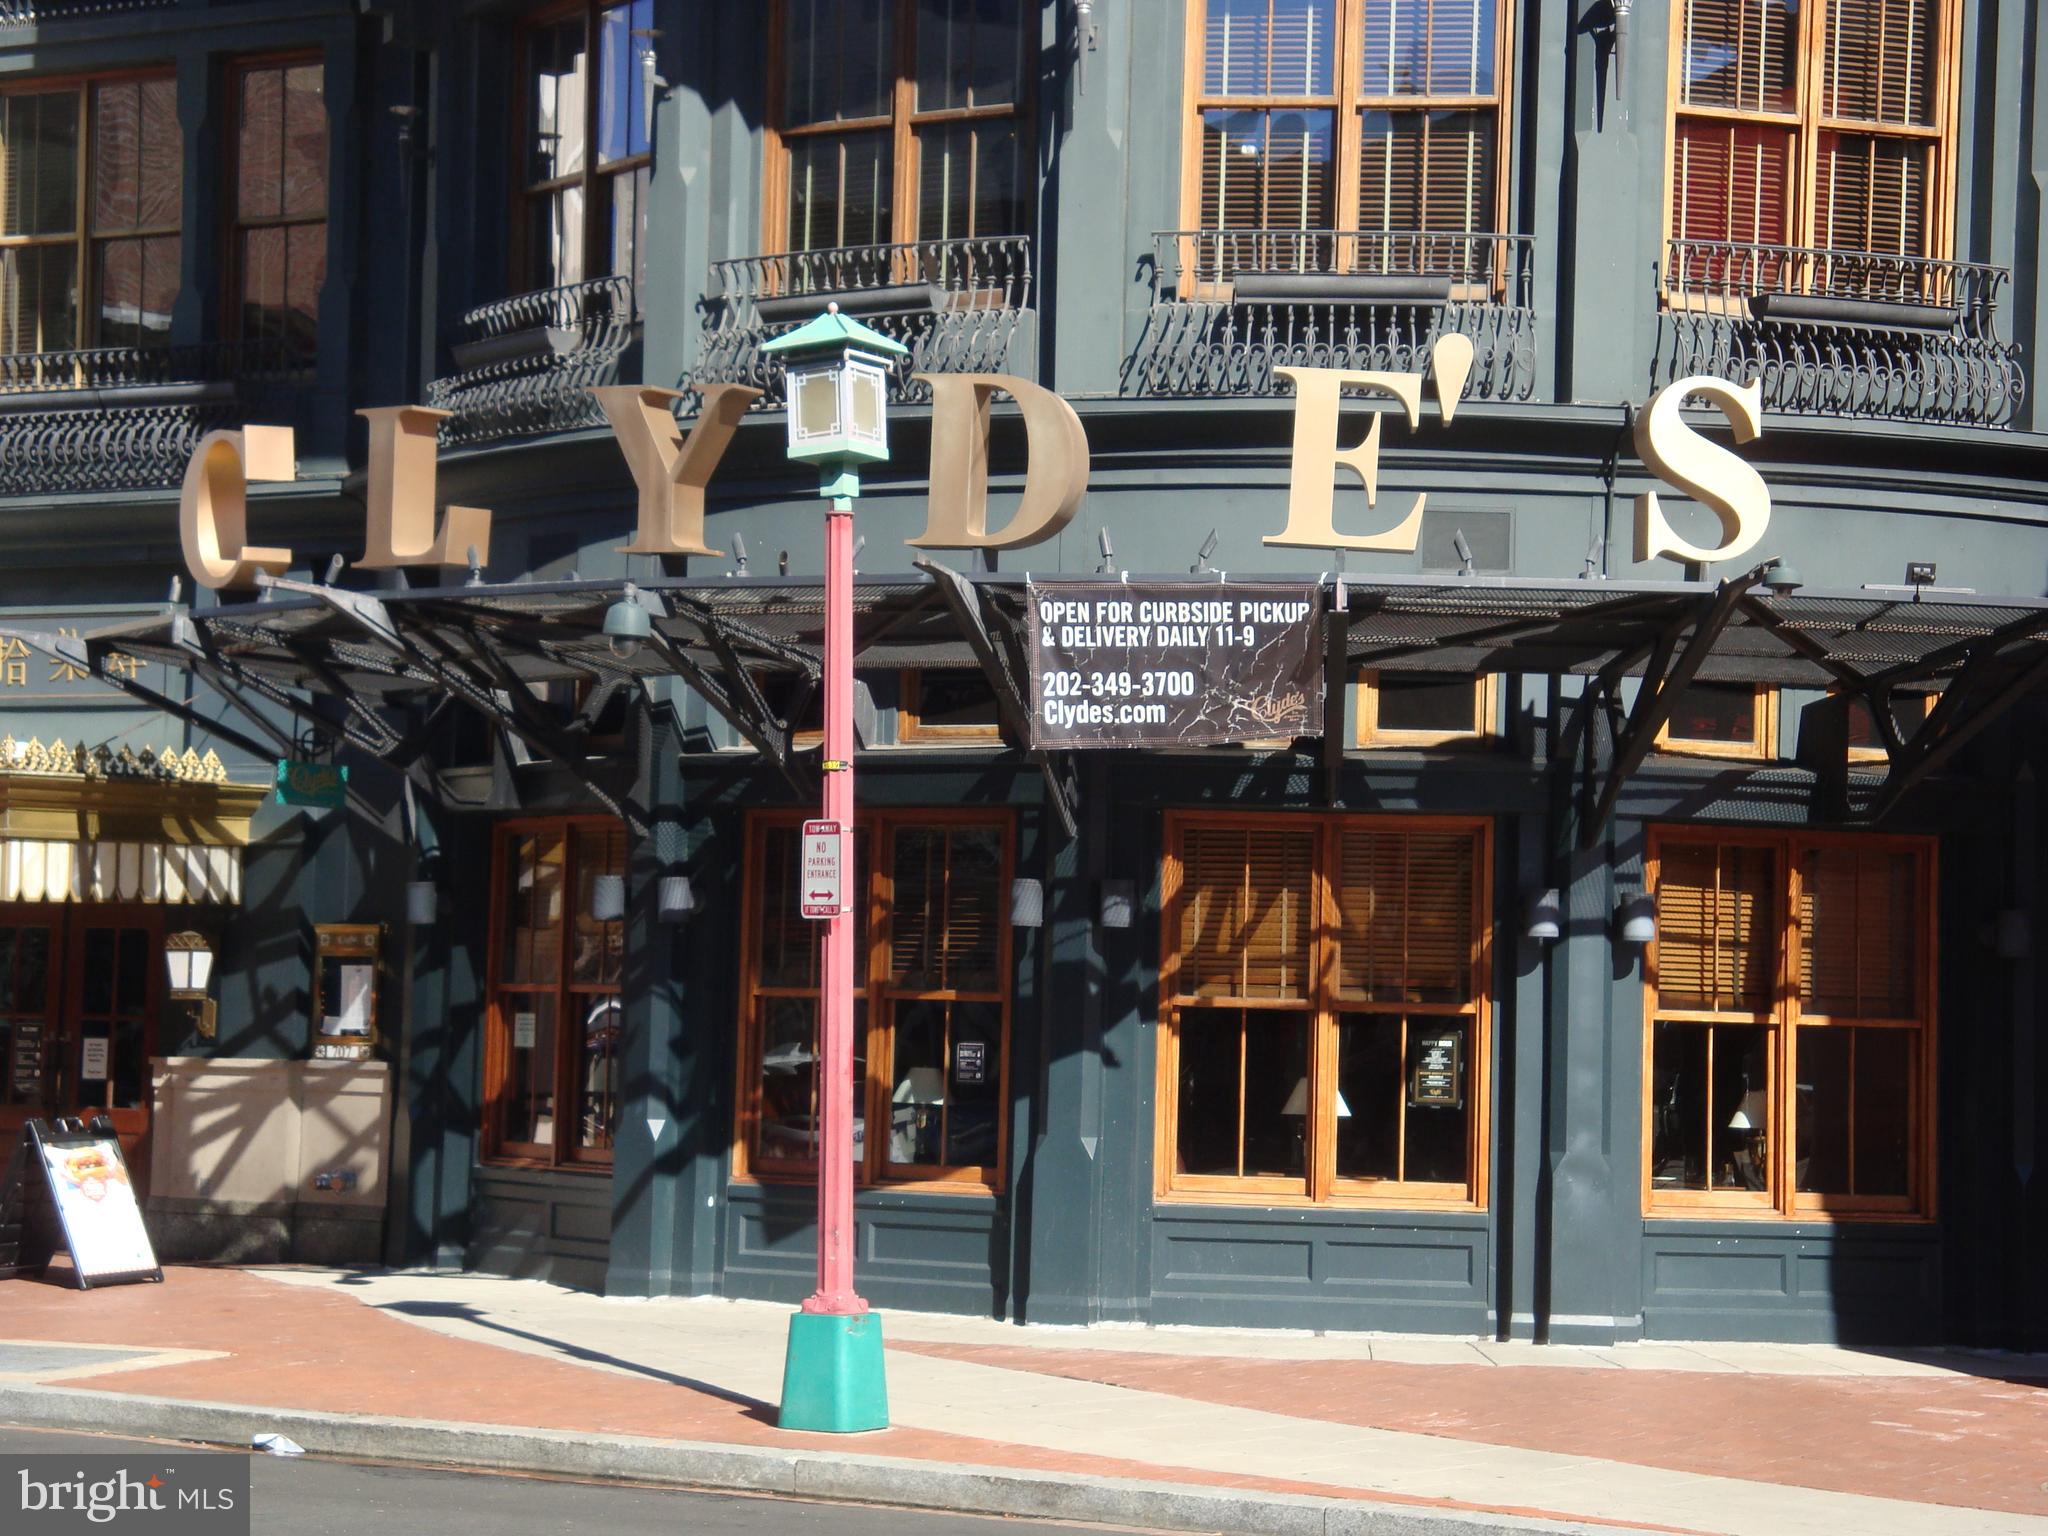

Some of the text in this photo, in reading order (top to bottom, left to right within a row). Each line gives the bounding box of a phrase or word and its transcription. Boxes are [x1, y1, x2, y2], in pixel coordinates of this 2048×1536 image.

[1040, 601, 1310, 623] OPEN FOR CURBSIDE PICKUP
[1042, 625, 1255, 647] & DELIVERY DAILY 11-9
[1043, 671, 1195, 697] 202-349-3700
[1044, 699, 1167, 729] Clydes.com
[808, 824, 837, 833] TOWAWAY
[816, 841, 826, 853] NO
[808, 857, 836, 866] PARKING
[807, 869, 837, 879] ENTRANCE
[332, 1044, 352, 1058] 707
